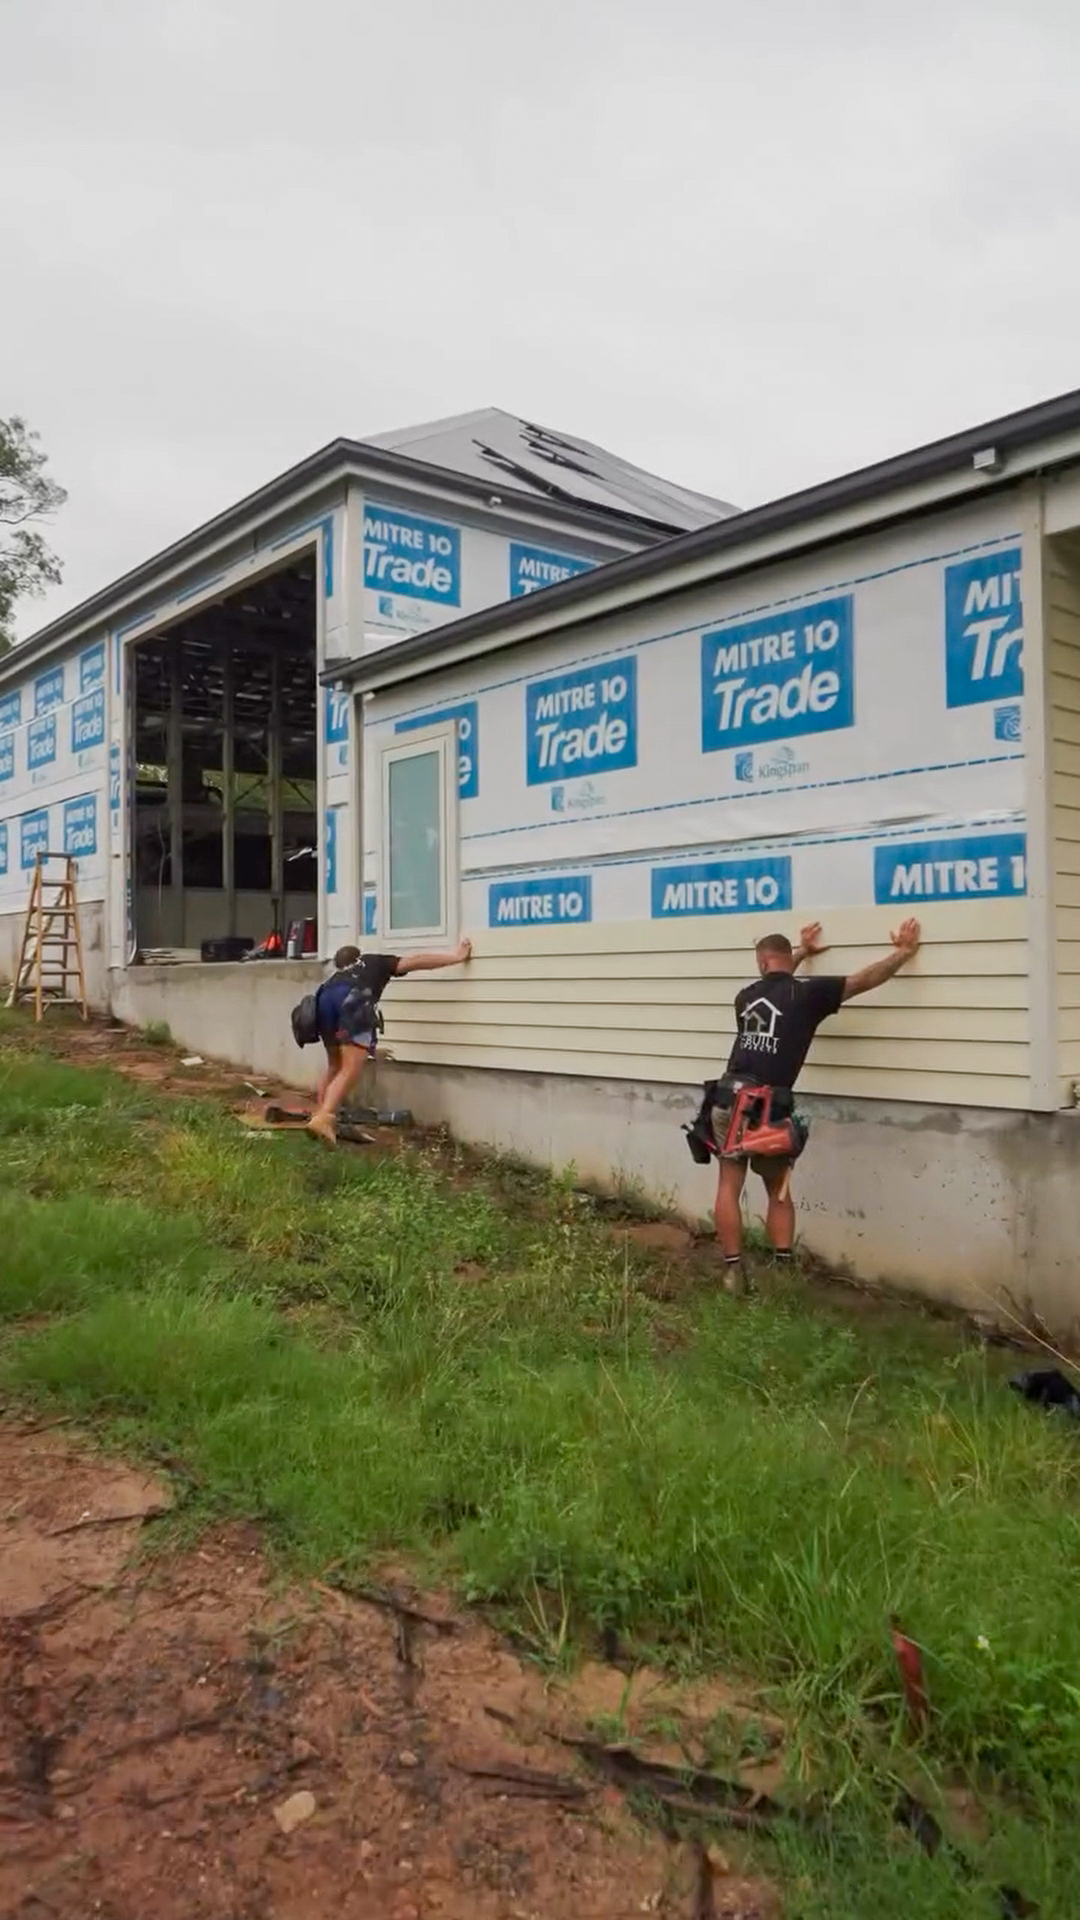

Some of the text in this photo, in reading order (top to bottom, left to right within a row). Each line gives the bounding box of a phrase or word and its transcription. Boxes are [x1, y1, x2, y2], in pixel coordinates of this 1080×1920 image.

[364, 517, 452, 556] MITRE 10
[364, 541, 452, 593] Trade
[712, 619, 840, 677] MITRE 10
[963, 614, 1024, 681] Tr
[535, 675, 627, 721] MITRE 10
[713, 661, 840, 731] Trade
[535, 711, 628, 768] Trade
[661, 875, 779, 910] MITRE 10
[890, 855, 1024, 896] MITRE 1
[497, 891, 583, 921] MITRE 10
